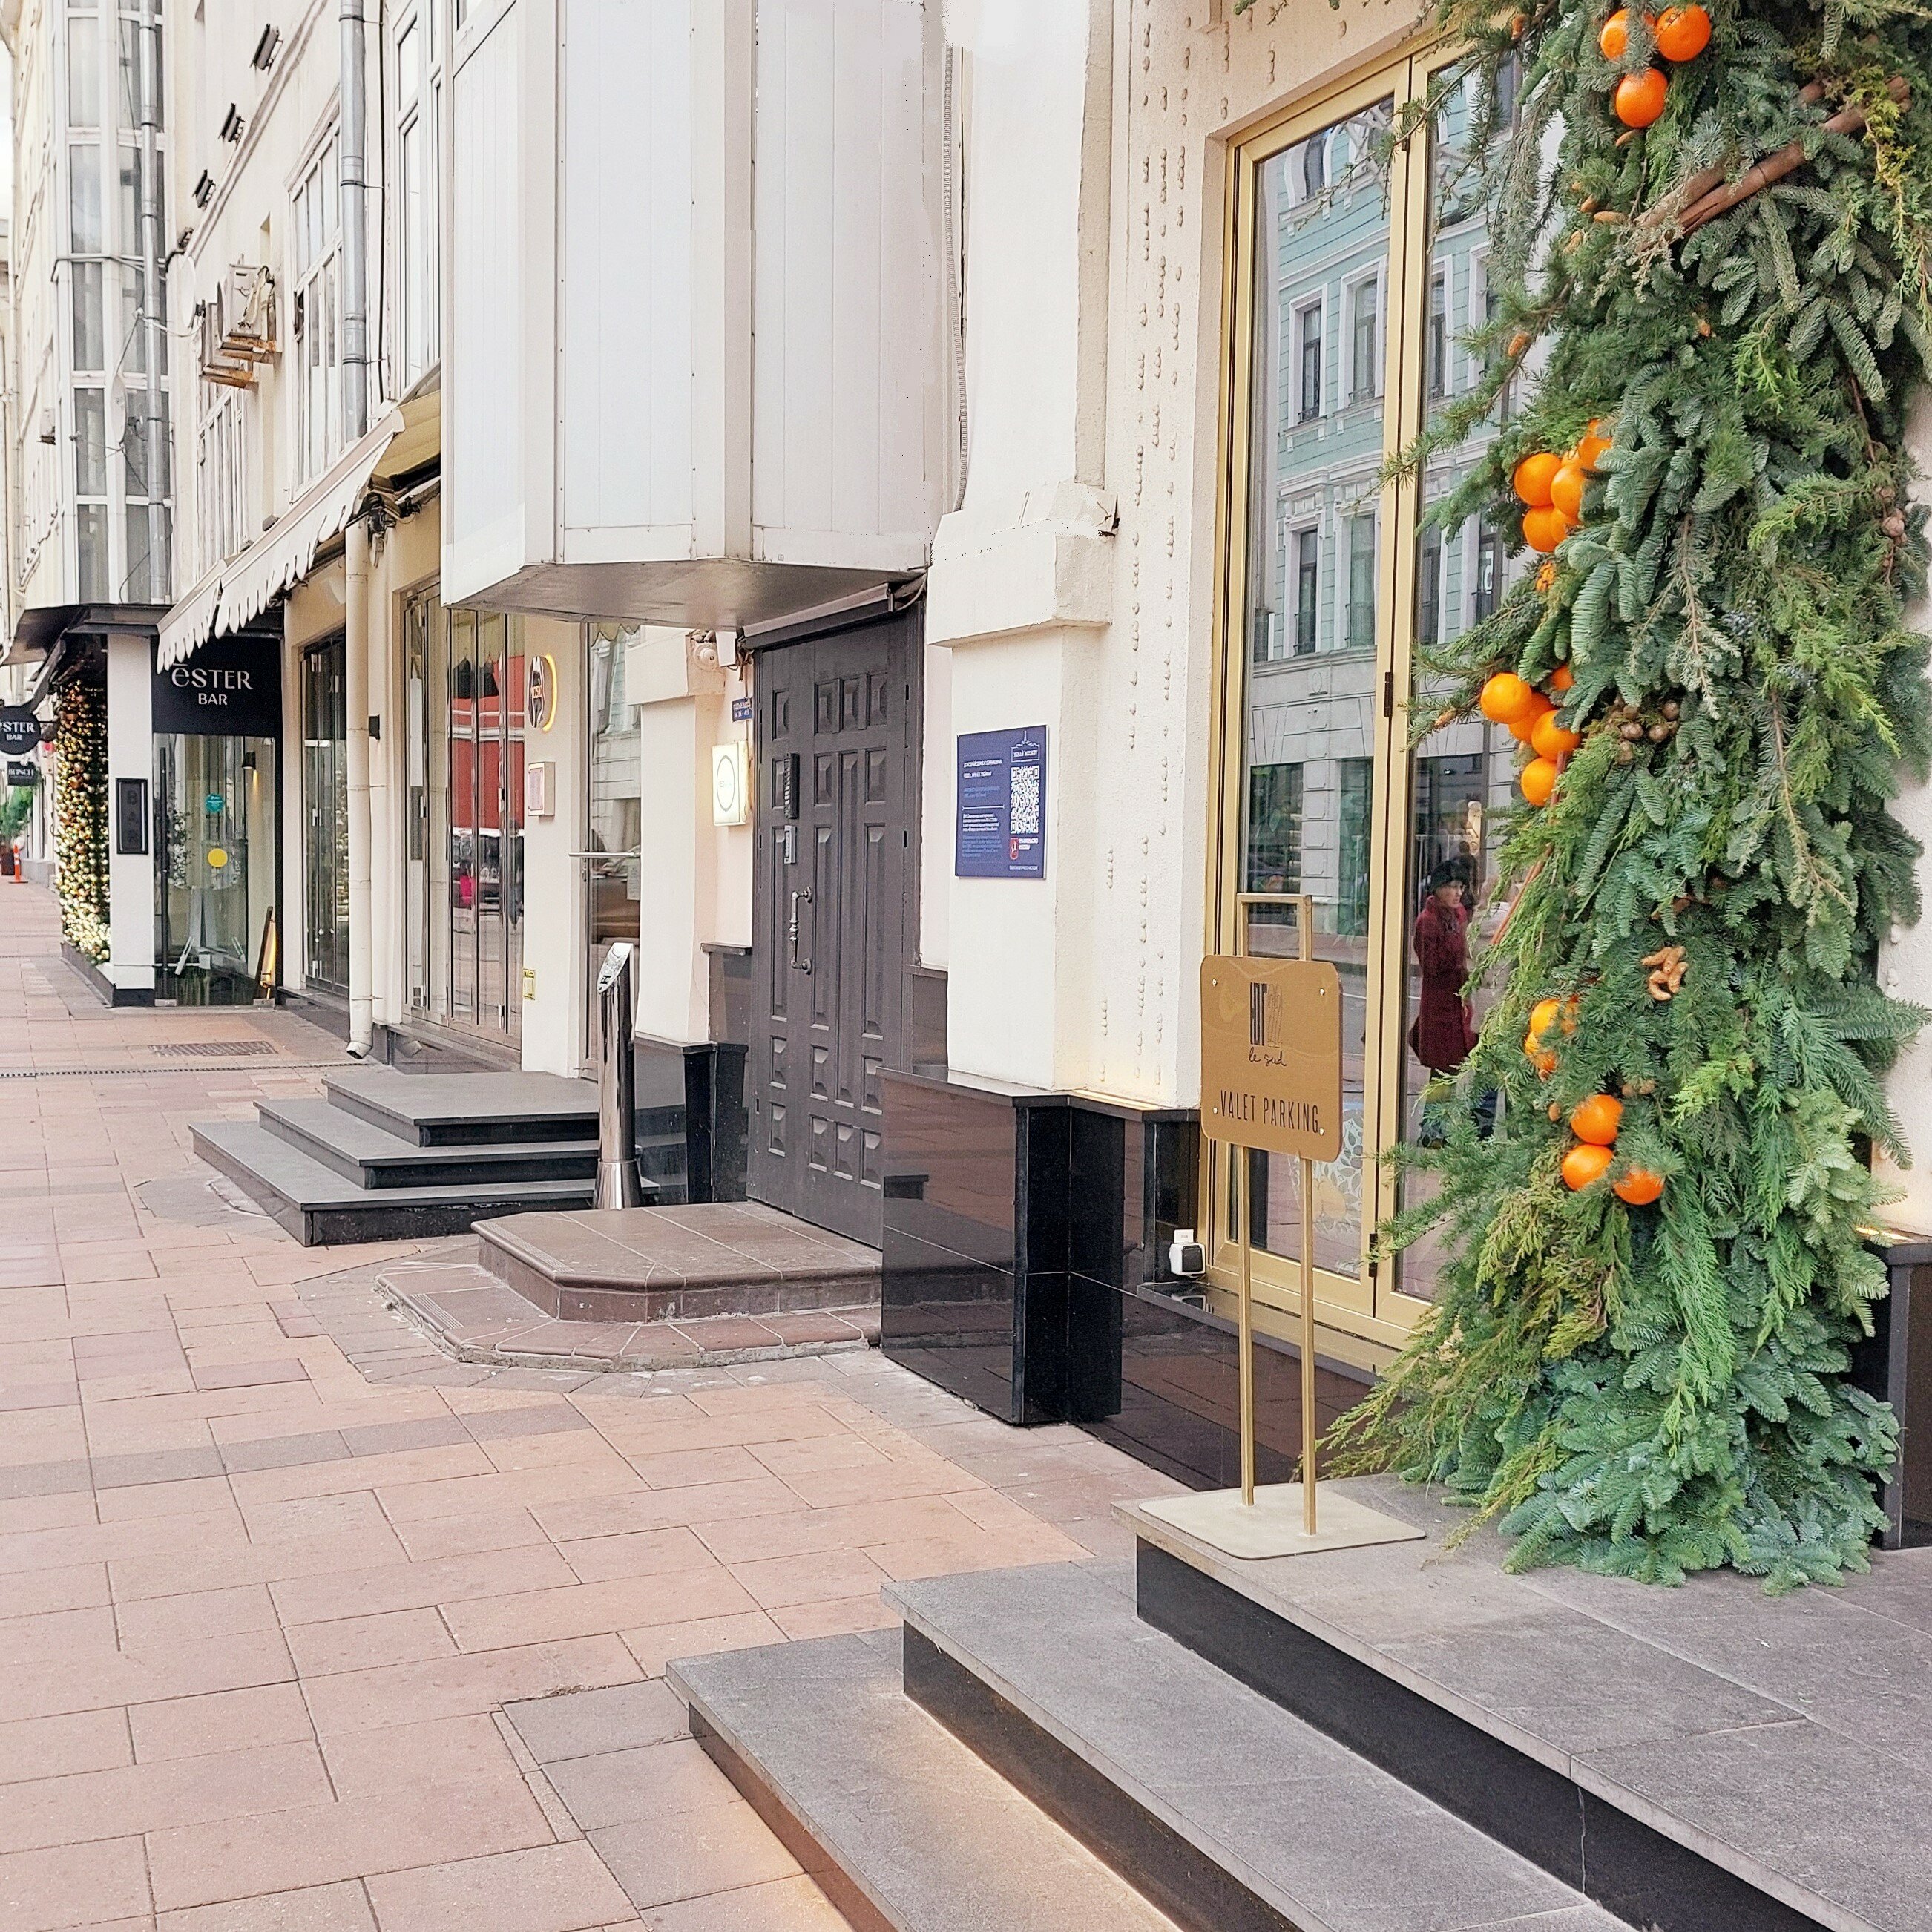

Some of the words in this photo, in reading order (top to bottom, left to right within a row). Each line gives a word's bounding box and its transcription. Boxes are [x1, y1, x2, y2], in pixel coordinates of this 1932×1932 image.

[198, 692, 228, 706] BAR
[1249, 1046, 1262, 1062] le
[1220, 1089, 1256, 1122] VALET
[1263, 1096, 1319, 1134] PARKING
